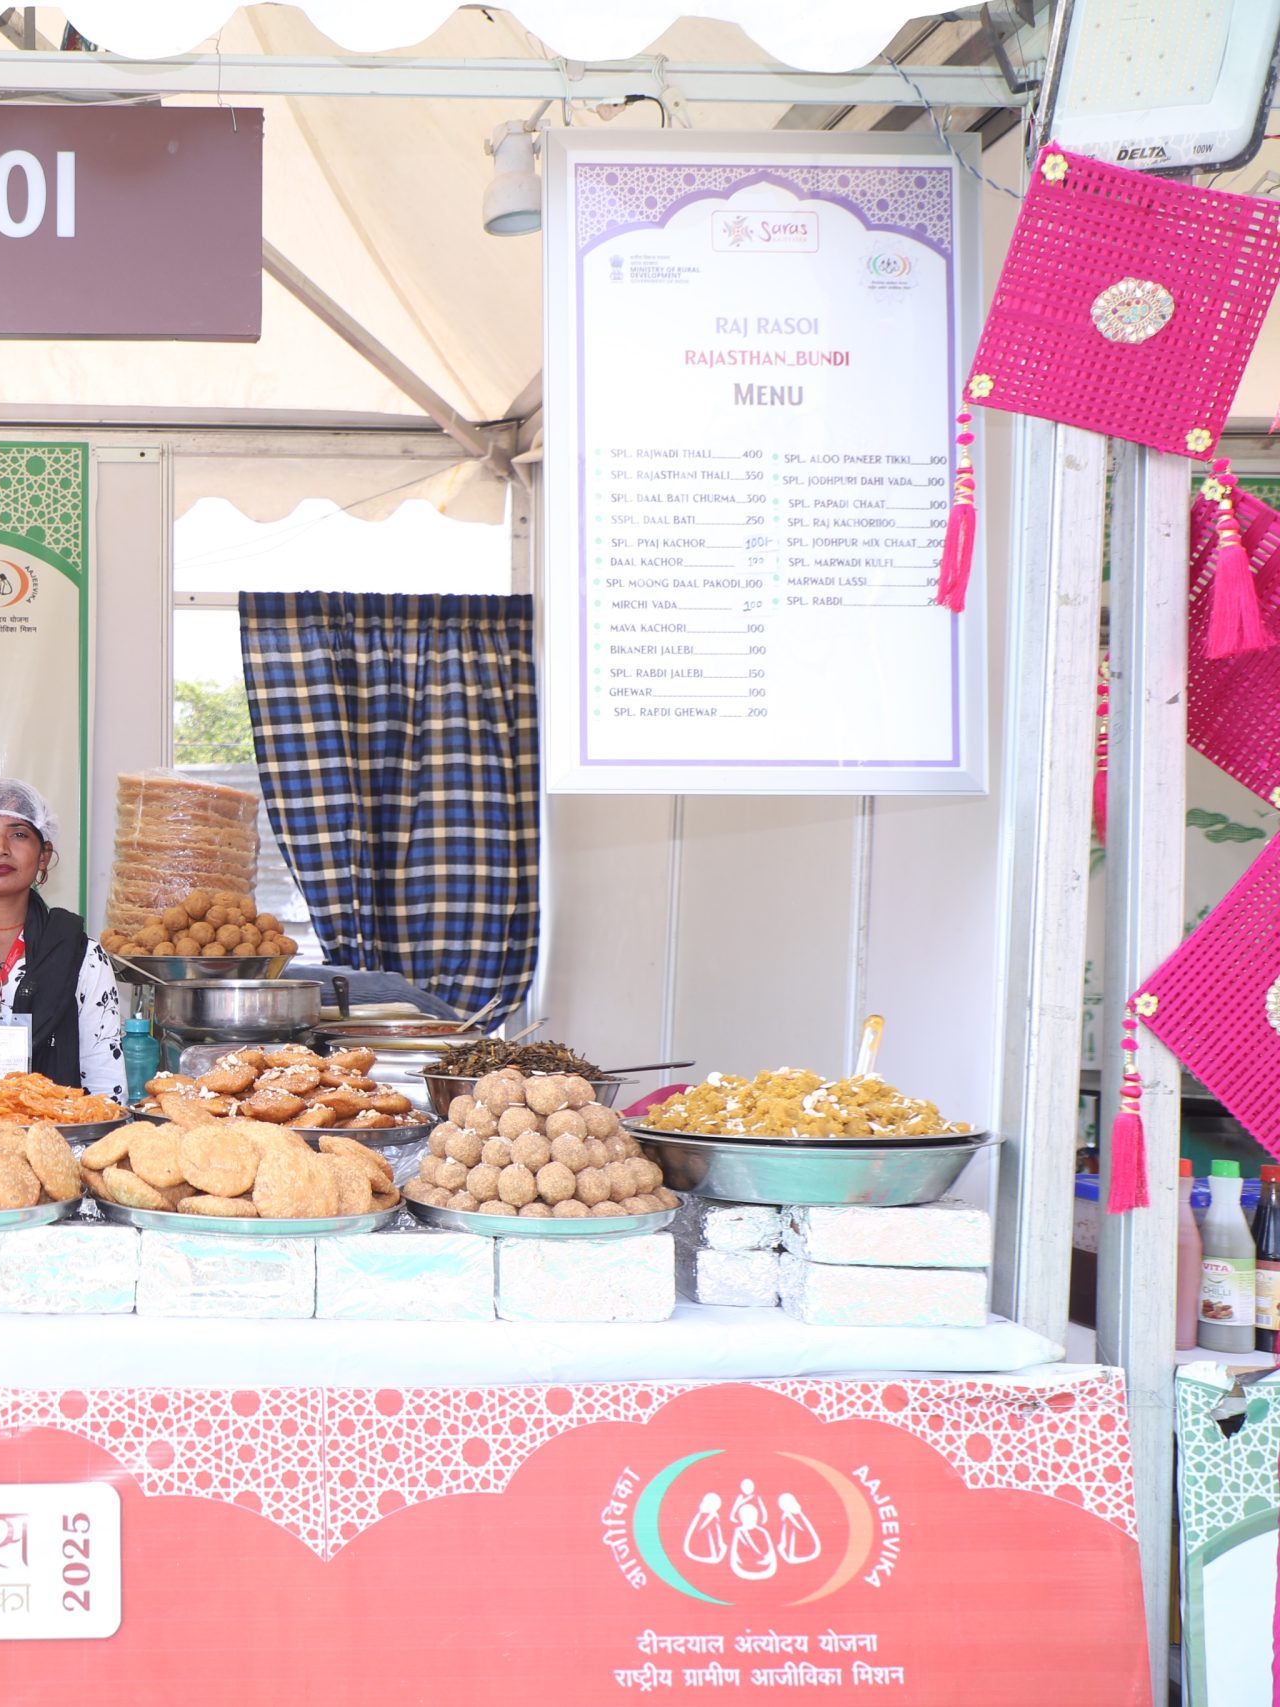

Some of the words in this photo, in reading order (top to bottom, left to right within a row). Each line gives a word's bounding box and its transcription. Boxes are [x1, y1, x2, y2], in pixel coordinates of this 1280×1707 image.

[1116, 146, 1167, 161] DELTA
[1193, 144, 1214, 155] 100W
[759, 221, 808, 242] Saras
[715, 317, 748, 338] RAJ
[757, 317, 819, 335] RASOI
[734, 383, 804, 406] MENU
[636, 449, 679, 459] RAJWADI
[682, 449, 711, 458] THALI
[742, 449, 763, 459] 400
[810, 454, 840, 464] ALOO
[843, 454, 882, 464] PANEER
[886, 454, 910, 464] TIKKI
[930, 455, 947, 465] 100
[636, 470, 698, 481] RAJASTHANI
[701, 470, 730, 480] THALI
[745, 471, 764, 480] 350
[808, 476, 857, 487] JODHPURI
[861, 476, 884, 486] DAHI
[888, 477, 913, 486] VADA
[928, 477, 945, 487] 100
[636, 494, 664, 503] DAAL
[667, 494, 689, 503] BATI
[693, 494, 736, 503] CHURMA
[747, 494, 767, 504] 300
[814, 499, 849, 509] PAPADI
[852, 499, 886, 509] CHAAT
[930, 500, 947, 510] 100
[643, 515, 670, 525] DAAL
[673, 515, 696, 525] BATI
[745, 515, 765, 525] 250
[813, 518, 830, 529] RAJ
[930, 519, 946, 528] 100
[637, 538, 659, 549] PYAJ
[663, 538, 706, 548] KACHOR
[812, 538, 858, 549] JODHPUR
[862, 538, 880, 548] MIX
[884, 538, 917, 548] CHAAT
[610, 557, 637, 566] DAAL
[640, 557, 683, 566] KACHOR
[814, 558, 861, 567] MARWADI
[865, 558, 894, 568] KULFI
[24, 565, 40, 604] AAJEEVIKA
[606, 578, 625, 588] SPL
[628, 578, 669, 588] MOONG
[673, 578, 700, 588] DAAL
[787, 577, 835, 586] MARWADI
[839, 577, 867, 587] LASSI
[612, 600, 648, 609] MIRCHI
[651, 600, 678, 609] VADA
[812, 596, 843, 605] RABDI
[610, 623, 637, 633] MAVA
[640, 623, 687, 633] KACHORI
[747, 624, 765, 633] 100
[610, 645, 657, 655] BIKANERI
[661, 645, 694, 656] JALEBI
[749, 645, 767, 655] 100
[636, 668, 667, 678] RABDI
[670, 669, 703, 680] JALEBI
[748, 669, 765, 679] 150
[609, 688, 653, 697] GHEWAR
[748, 688, 766, 697] 100
[674, 707, 718, 717] GHEWAR
[747, 708, 768, 718] 200
[1202, 1263, 1230, 1273] VITA
[852, 1464, 901, 1589] AAJEEVIKA
[62, 1512, 91, 1612] 2025
[637, 1629, 725, 1655] दीनदयाल
[733, 1628, 809, 1655] अंत्योदय
[817, 1628, 878, 1653] योजना
[613, 1661, 673, 1692] राष्ट्रीय
[682, 1661, 741, 1688] ग्रामीण
[750, 1661, 842, 1687] आजीविका
[852, 1661, 905, 1686] मिशन
